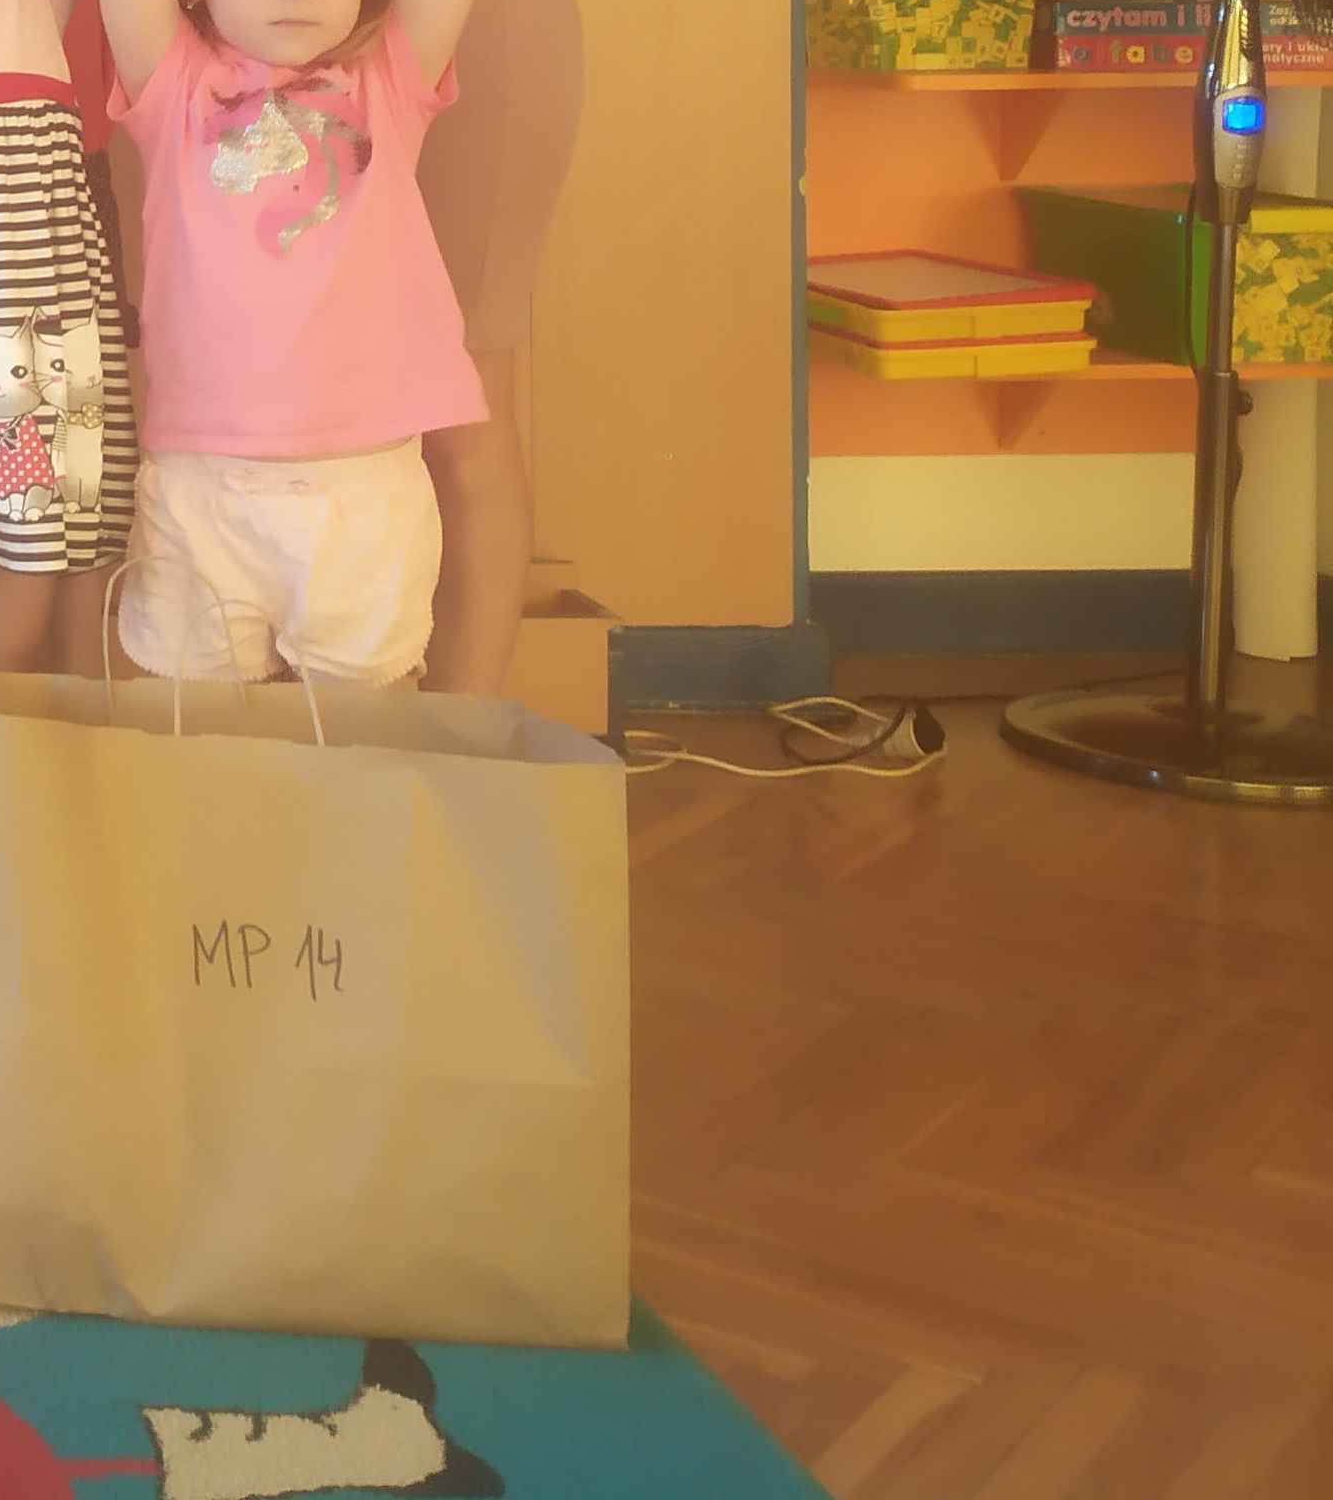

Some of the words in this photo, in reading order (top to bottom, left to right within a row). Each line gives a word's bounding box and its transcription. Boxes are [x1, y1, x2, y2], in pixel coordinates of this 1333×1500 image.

[1066, 6, 1168, 32] czytam
[191, 918, 272, 989] MP
[295, 923, 346, 1003] 14
